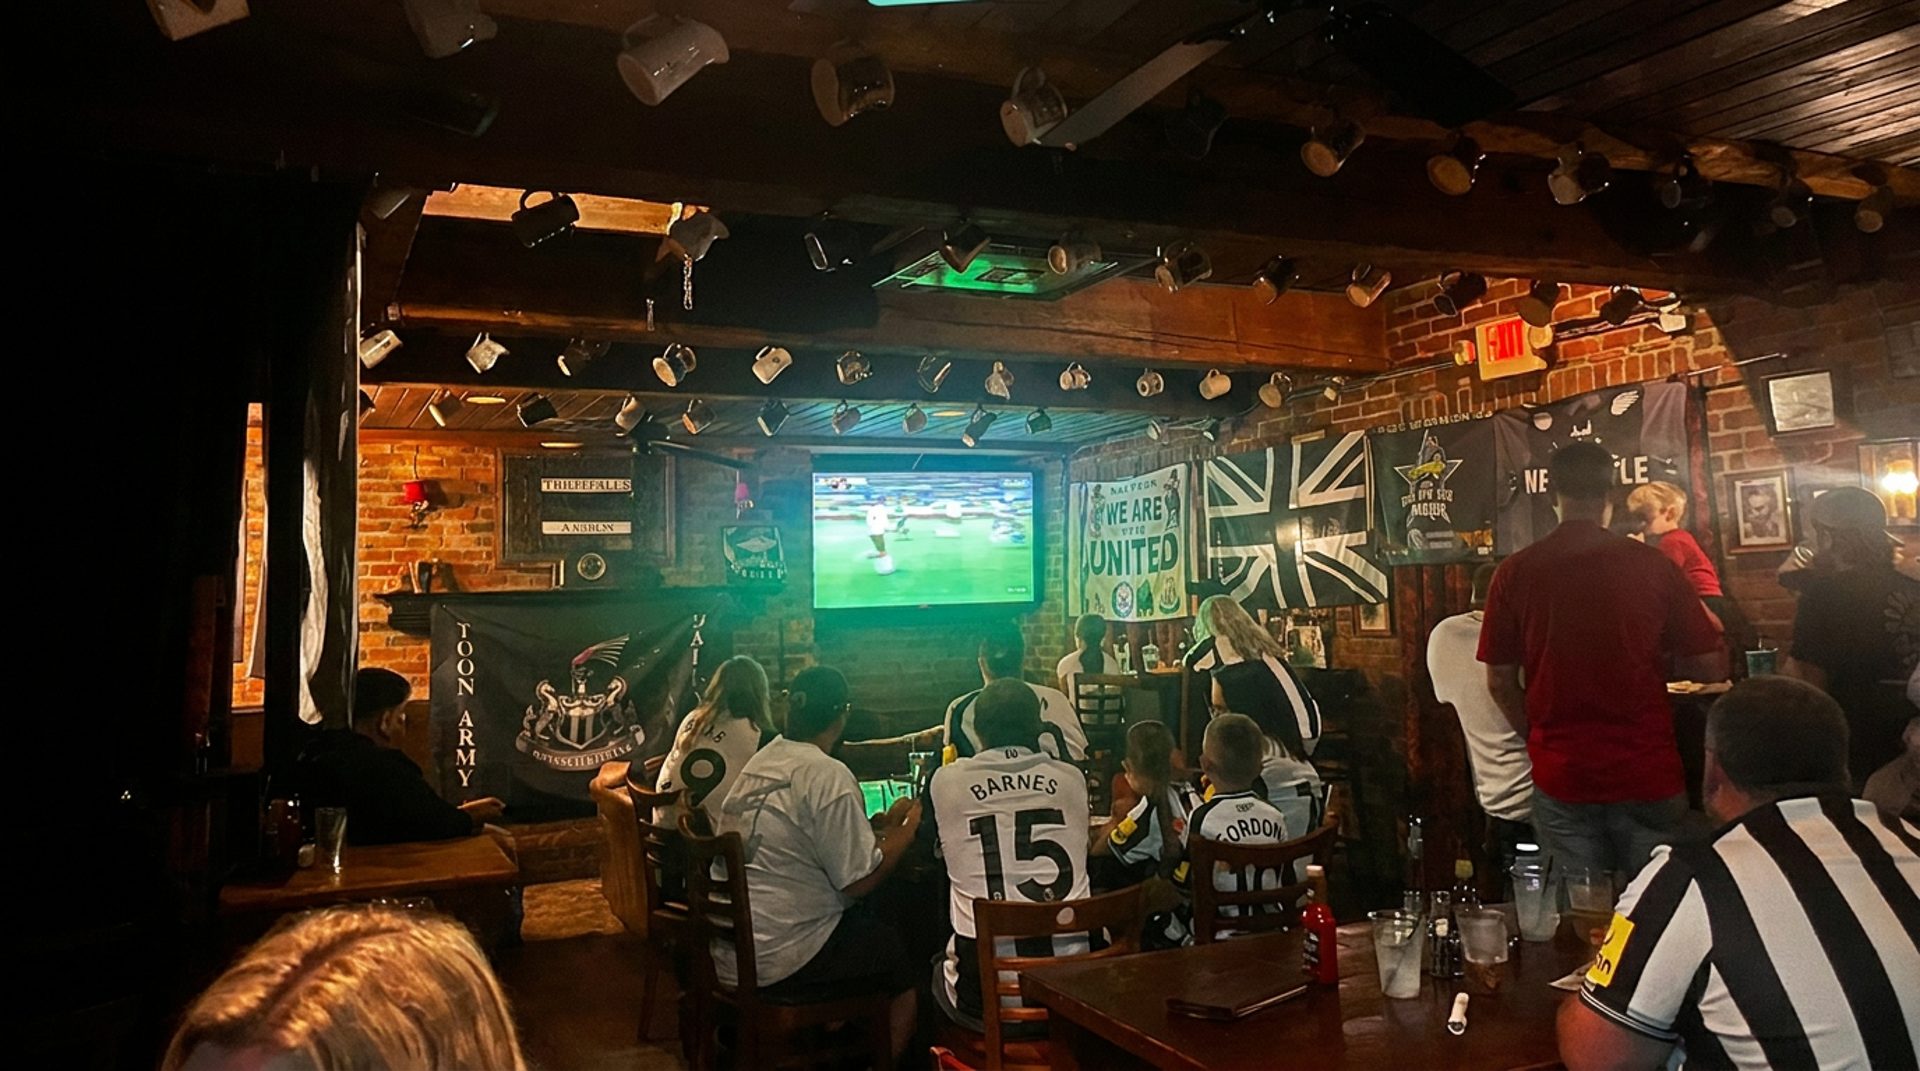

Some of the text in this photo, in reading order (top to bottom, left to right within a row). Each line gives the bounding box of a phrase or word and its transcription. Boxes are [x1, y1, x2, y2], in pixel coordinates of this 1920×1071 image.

[1485, 319, 1524, 362] EXIT
[1107, 496, 1162, 525] WE ARE
[1090, 532, 1178, 576] UNITED
[456, 622, 476, 787] TOON ARMY
[681, 748, 726, 807] 9
[970, 774, 1058, 801] BARNES
[969, 808, 1074, 902] 15
